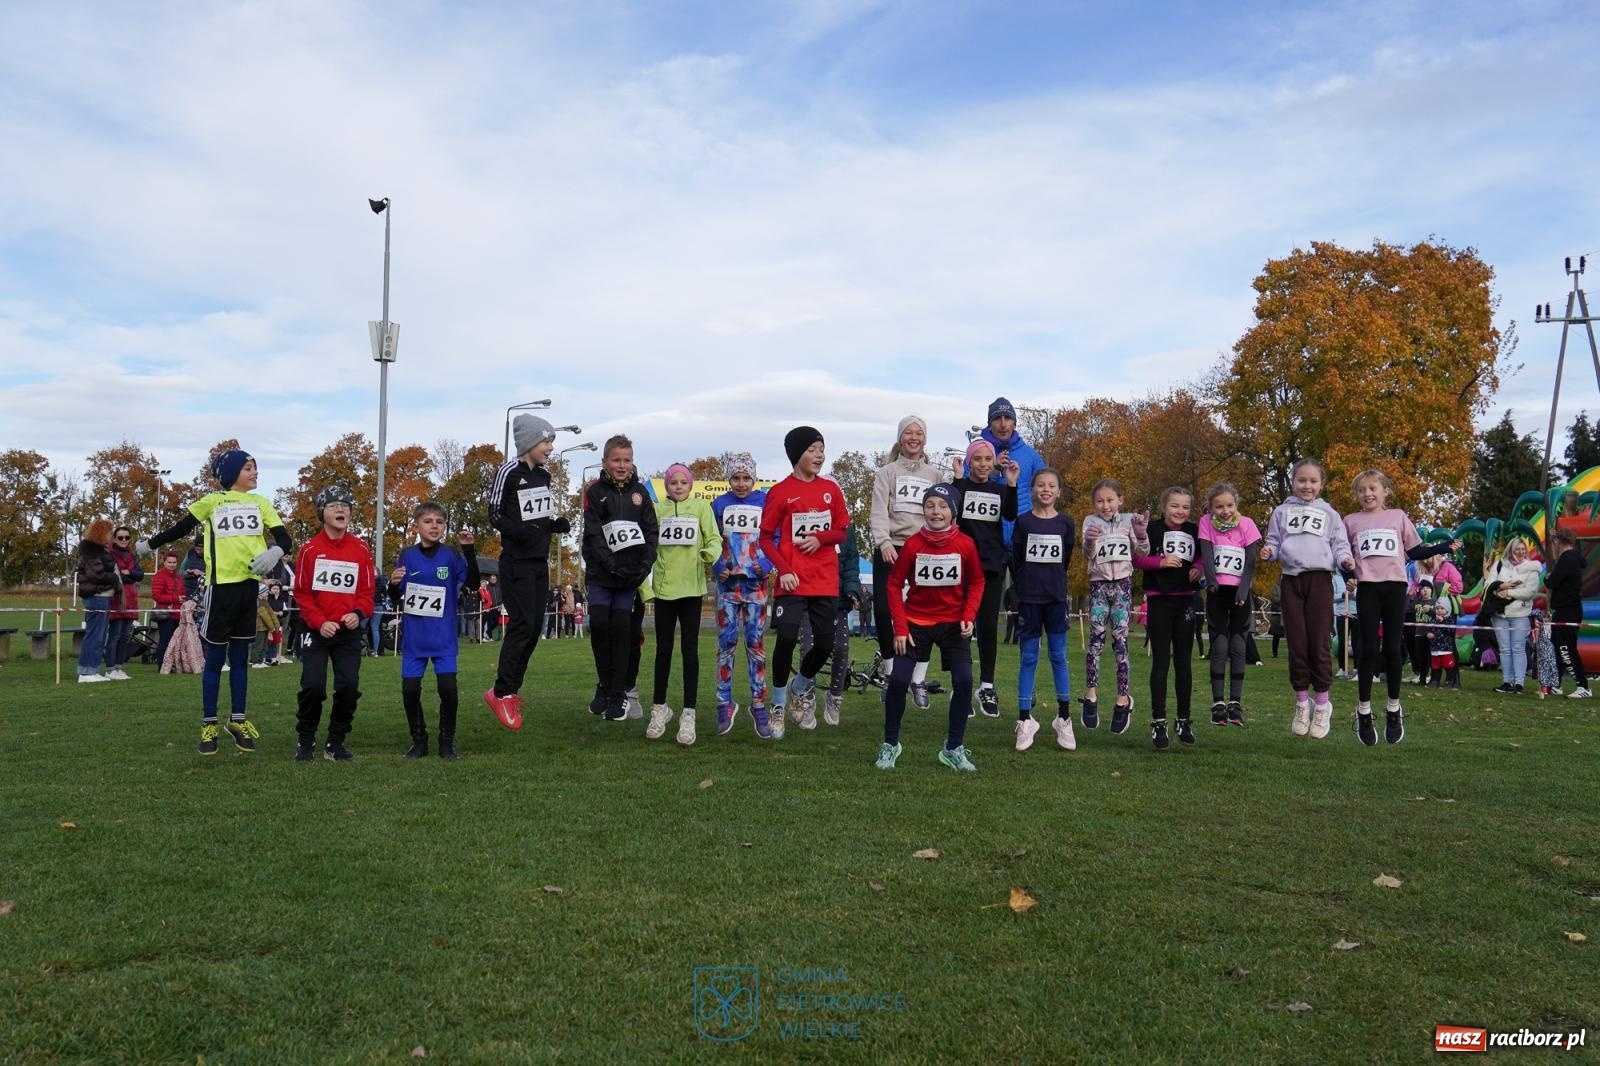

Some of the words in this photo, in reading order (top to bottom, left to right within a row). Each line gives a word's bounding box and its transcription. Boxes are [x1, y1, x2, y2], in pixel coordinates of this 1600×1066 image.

[523, 496, 551, 514] 477
[965, 501, 998, 516] 465
[217, 514, 259, 531] 463
[725, 514, 759, 528] 481
[1288, 515, 1322, 530] 475
[608, 528, 641, 546] 462
[661, 527, 695, 540] 480
[1028, 544, 1060, 558] 478
[1098, 543, 1128, 558] 472
[1166, 541, 1193, 556] 551
[1360, 538, 1396, 551] 470
[1214, 554, 1243, 571] 473
[316, 570, 355, 588] 469
[918, 565, 958, 580] 464
[406, 594, 442, 611] 474
[300, 632, 313, 648] 14
[1560, 645, 1572, 665] CAMP
